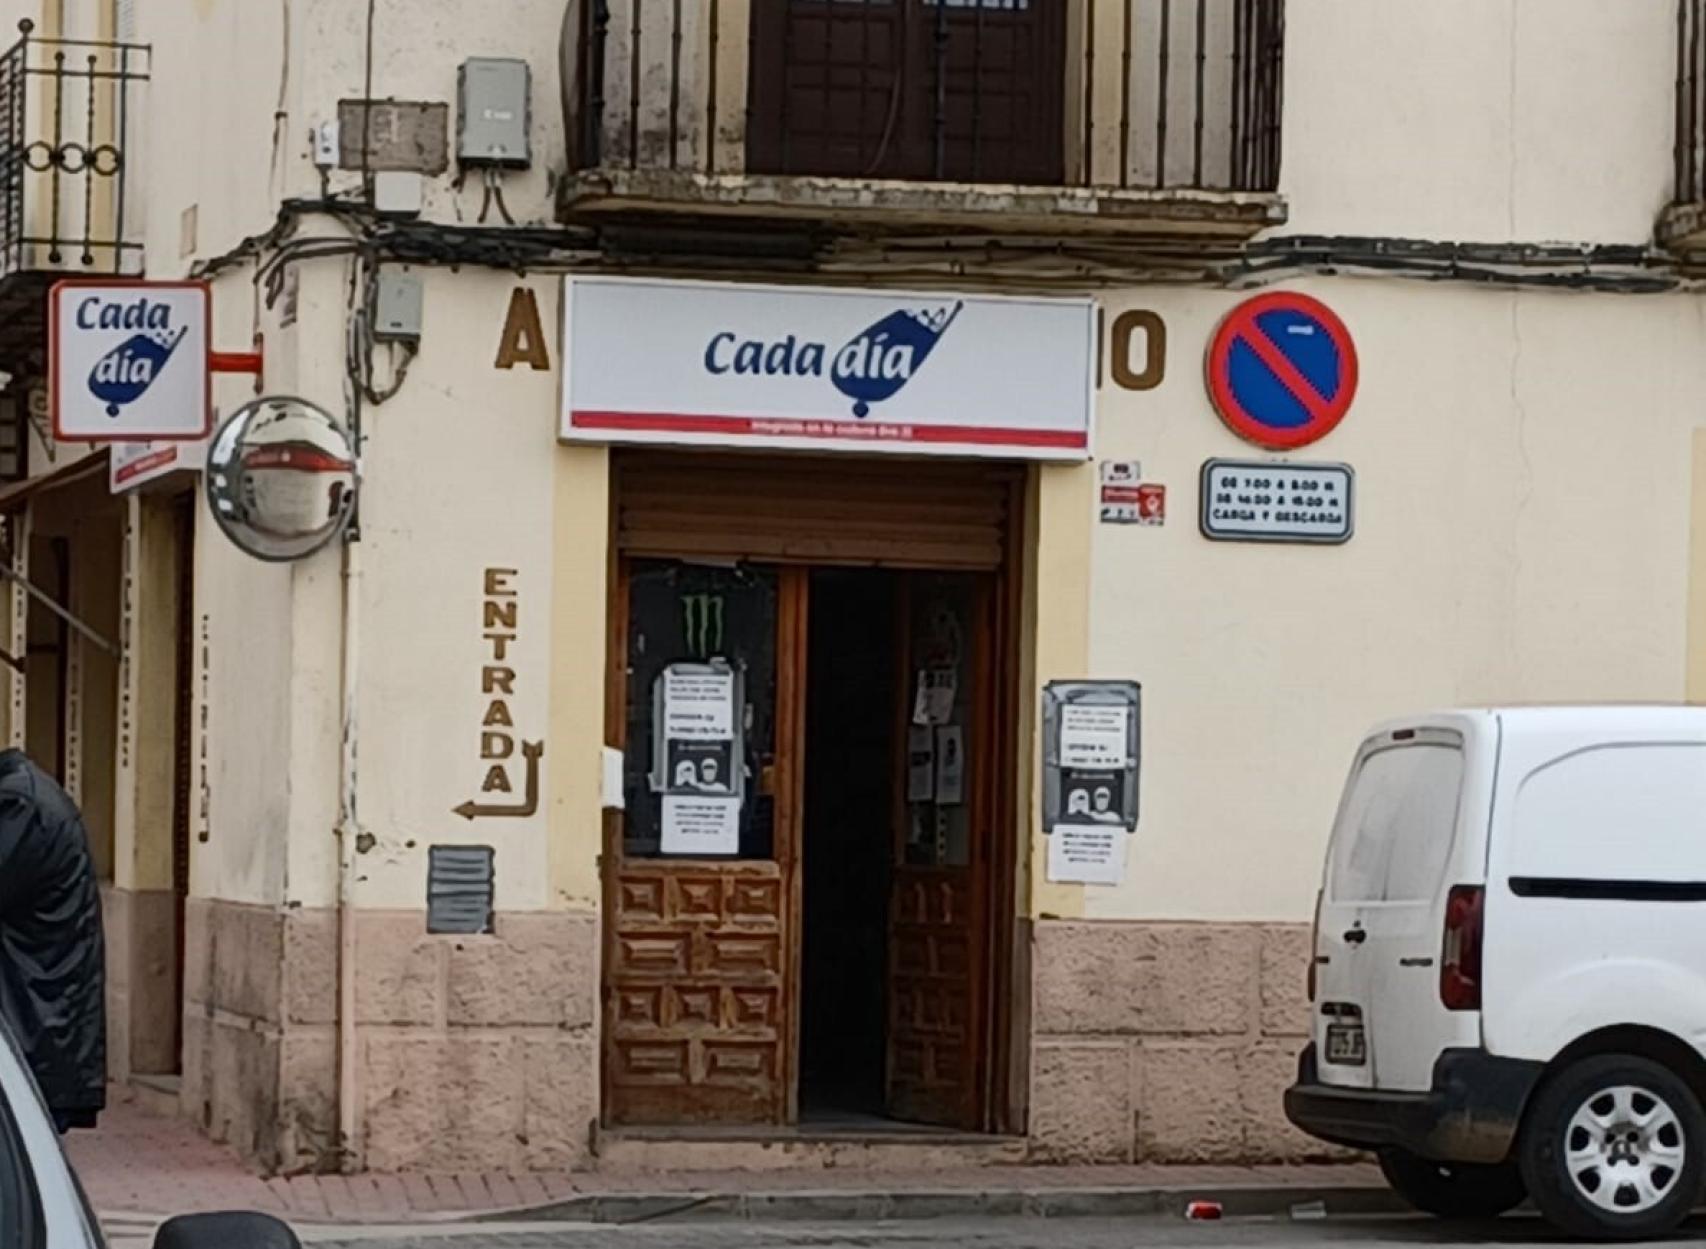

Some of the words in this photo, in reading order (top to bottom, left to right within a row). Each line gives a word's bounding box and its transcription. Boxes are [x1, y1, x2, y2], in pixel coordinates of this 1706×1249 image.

[76, 297, 171, 330] Cada
[494, 286, 549, 370] A
[95, 349, 153, 384] día
[704, 331, 826, 377] Cada
[835, 332, 914, 380] día
[1213, 508, 1256, 520] CARGA
[1275, 511, 1342, 523] DESCARGA
[480, 568, 518, 793] ENTRADA
